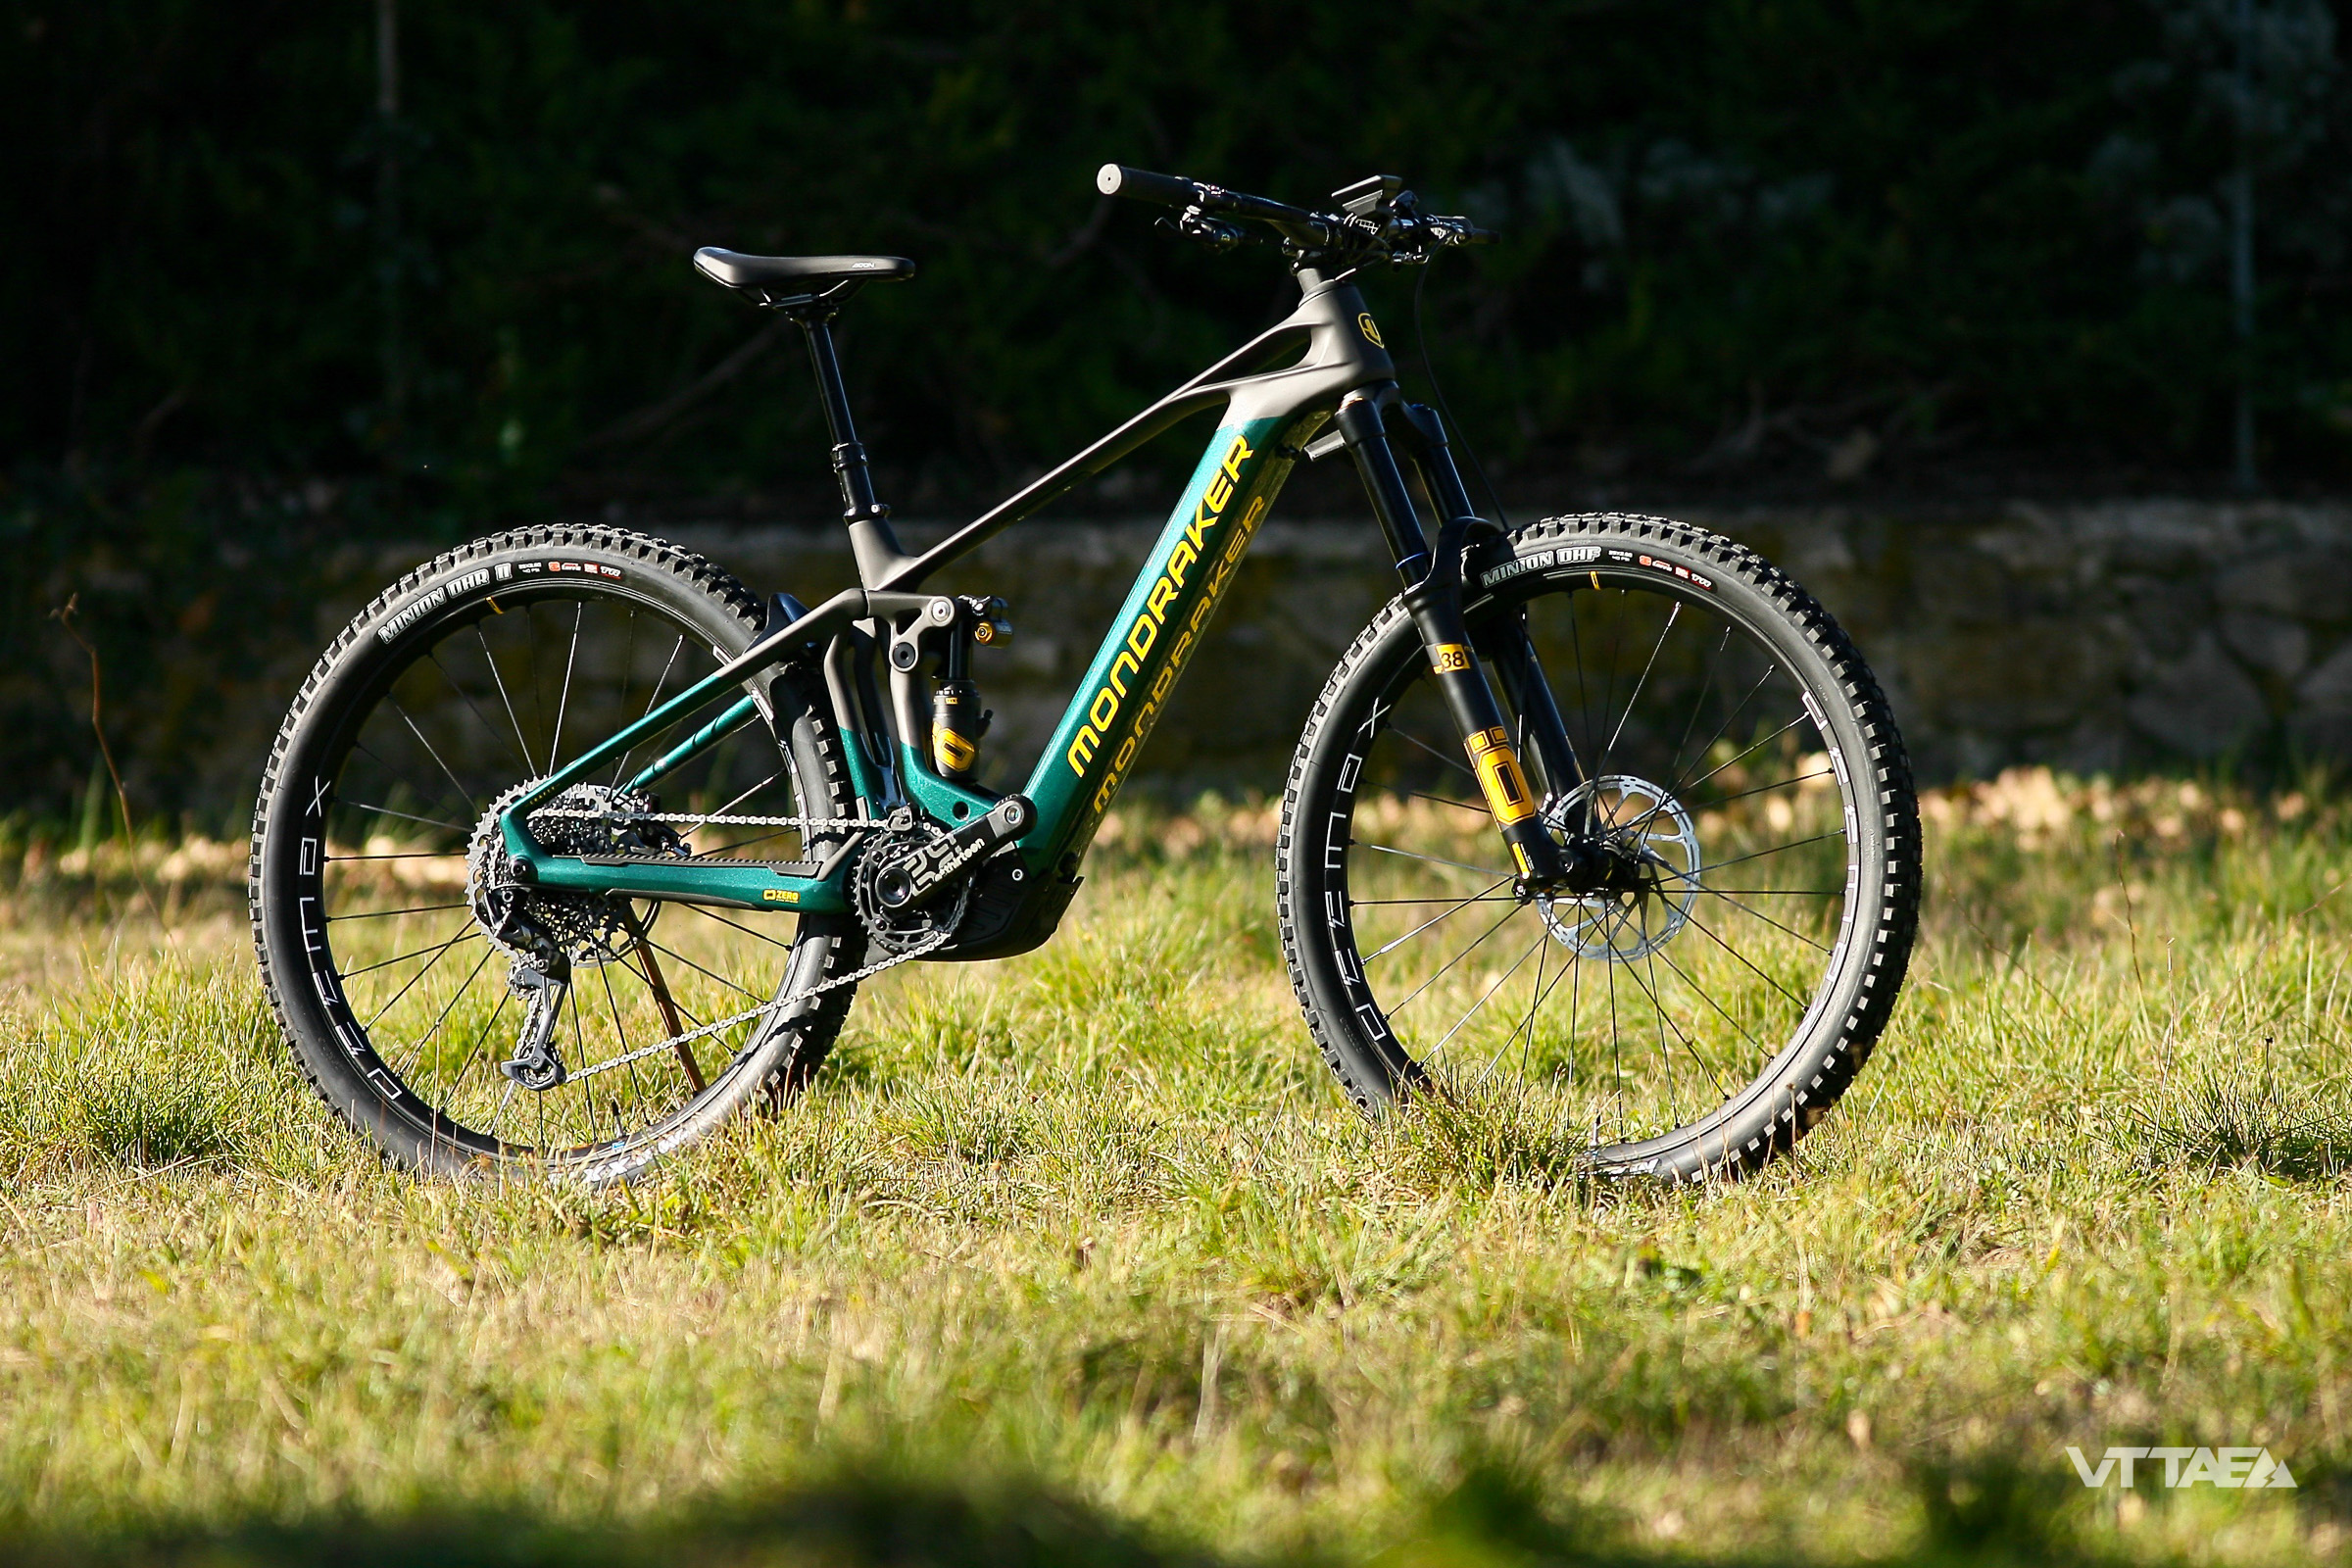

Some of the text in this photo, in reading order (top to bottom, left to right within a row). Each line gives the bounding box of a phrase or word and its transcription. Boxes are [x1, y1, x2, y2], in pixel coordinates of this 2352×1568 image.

[1480, 546, 1602, 588] MINION DHF
[377, 563, 513, 645] MINION DHR II
[1066, 434, 1253, 777] MONDRAKER
[1093, 495, 1265, 814] MONDRAKER
[1441, 651, 1465, 668] 38
[776, 890, 799, 901] ZERO
